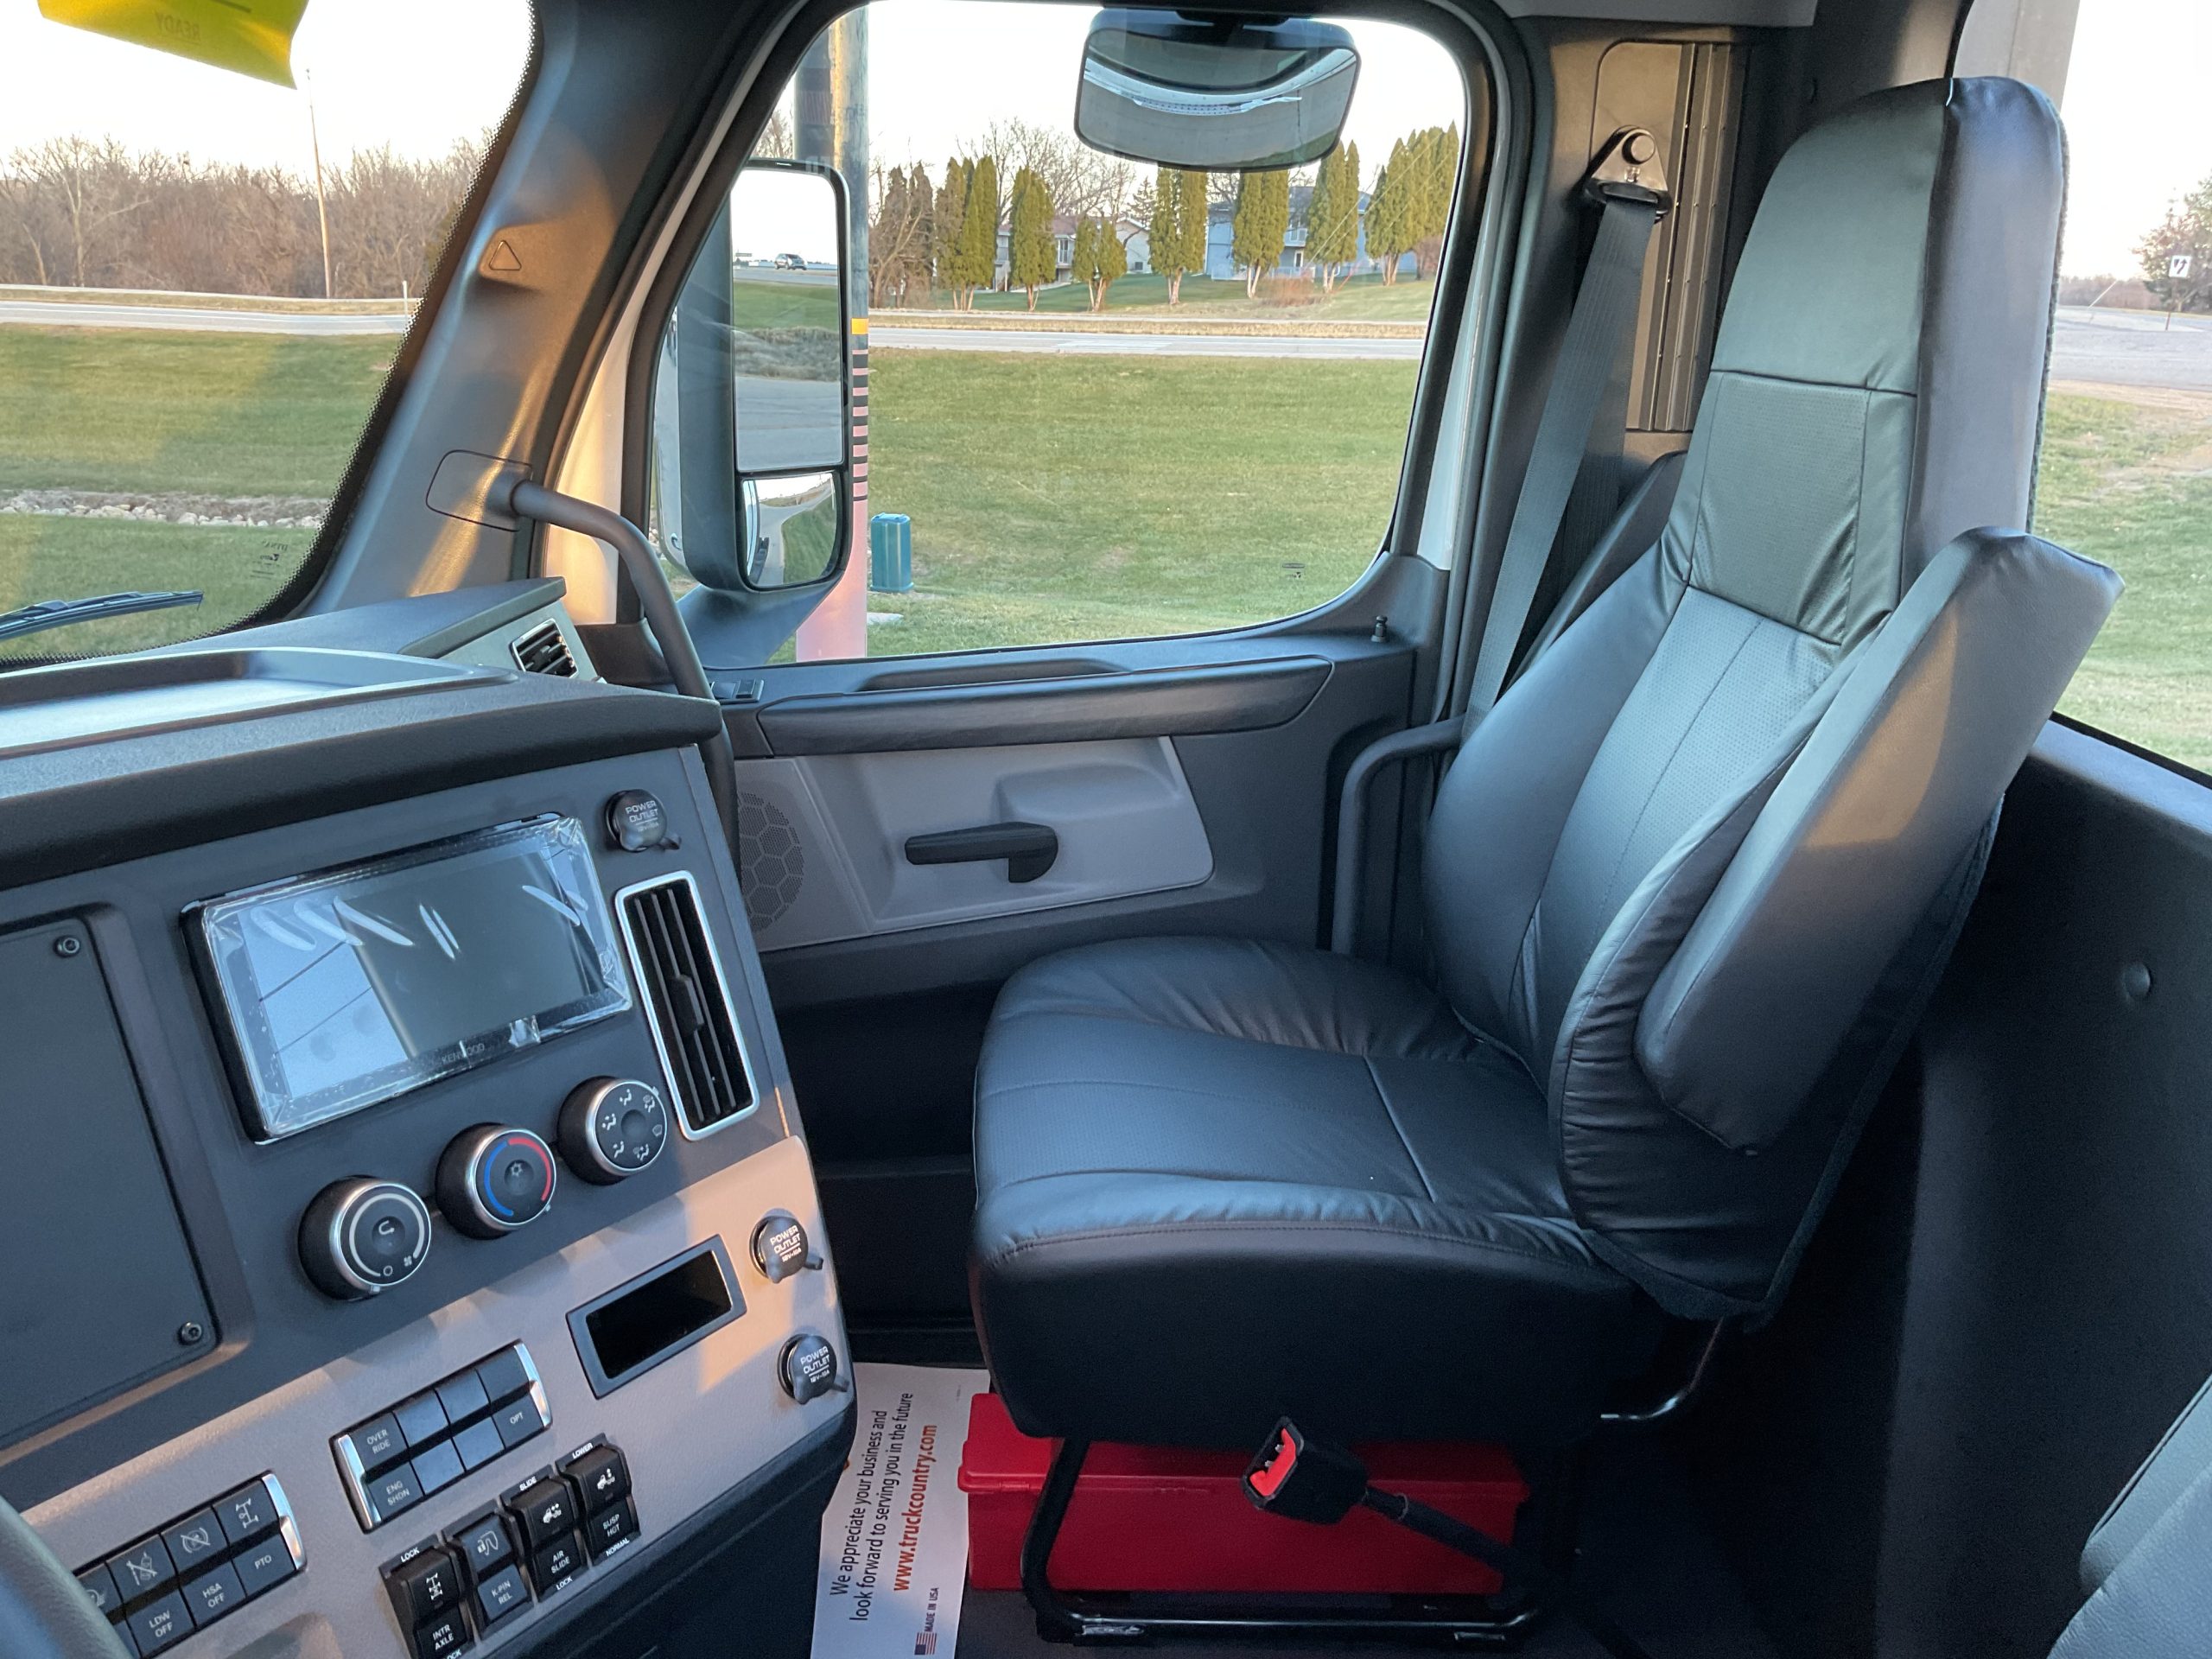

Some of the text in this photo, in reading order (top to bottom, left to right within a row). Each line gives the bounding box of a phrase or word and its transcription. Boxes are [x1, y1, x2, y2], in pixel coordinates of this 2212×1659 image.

[625, 800, 657, 814] POWER
[629, 809, 658, 823] OUTLET
[770, 1224, 799, 1246] POWER
[773, 1233, 801, 1254] OUTLET
[800, 1345, 829, 1365] POWER
[803, 1354, 830, 1374] OUTLET
[510, 1411, 524, 1424] OPT
[366, 1429, 388, 1445] OVER
[372, 1439, 391, 1454] RIDE
[571, 1442, 594, 1459] LOWER
[385, 1480, 404, 1495] ENG
[519, 1476, 537, 1491] SLIDE
[387, 1488, 410, 1505] SHDN
[830, 1410, 887, 1596] We appreciate your business and
[849, 1392, 913, 1620] look forward to serving you in the future
[893, 1424, 938, 1591] www.truckcountry.com
[602, 1514, 620, 1529] SUSP
[400, 1547, 420, 1562] LOCK
[606, 1537, 630, 1556] NORMAL
[254, 1554, 272, 1569] PTO
[552, 1549, 564, 1563] AIR
[550, 1556, 570, 1573] SLIDE
[556, 1575, 573, 1590] LOCK
[201, 1583, 222, 1599] HSA
[498, 1592, 512, 1605] REL
[929, 1587, 939, 1601] USA
[207, 1593, 225, 1608] OFF
[149, 1610, 171, 1628] LDW
[925, 1612, 936, 1632] MADE
[155, 1622, 173, 1637] OFF
[432, 1624, 450, 1641] INTR
[435, 1633, 454, 1650] AXLE
